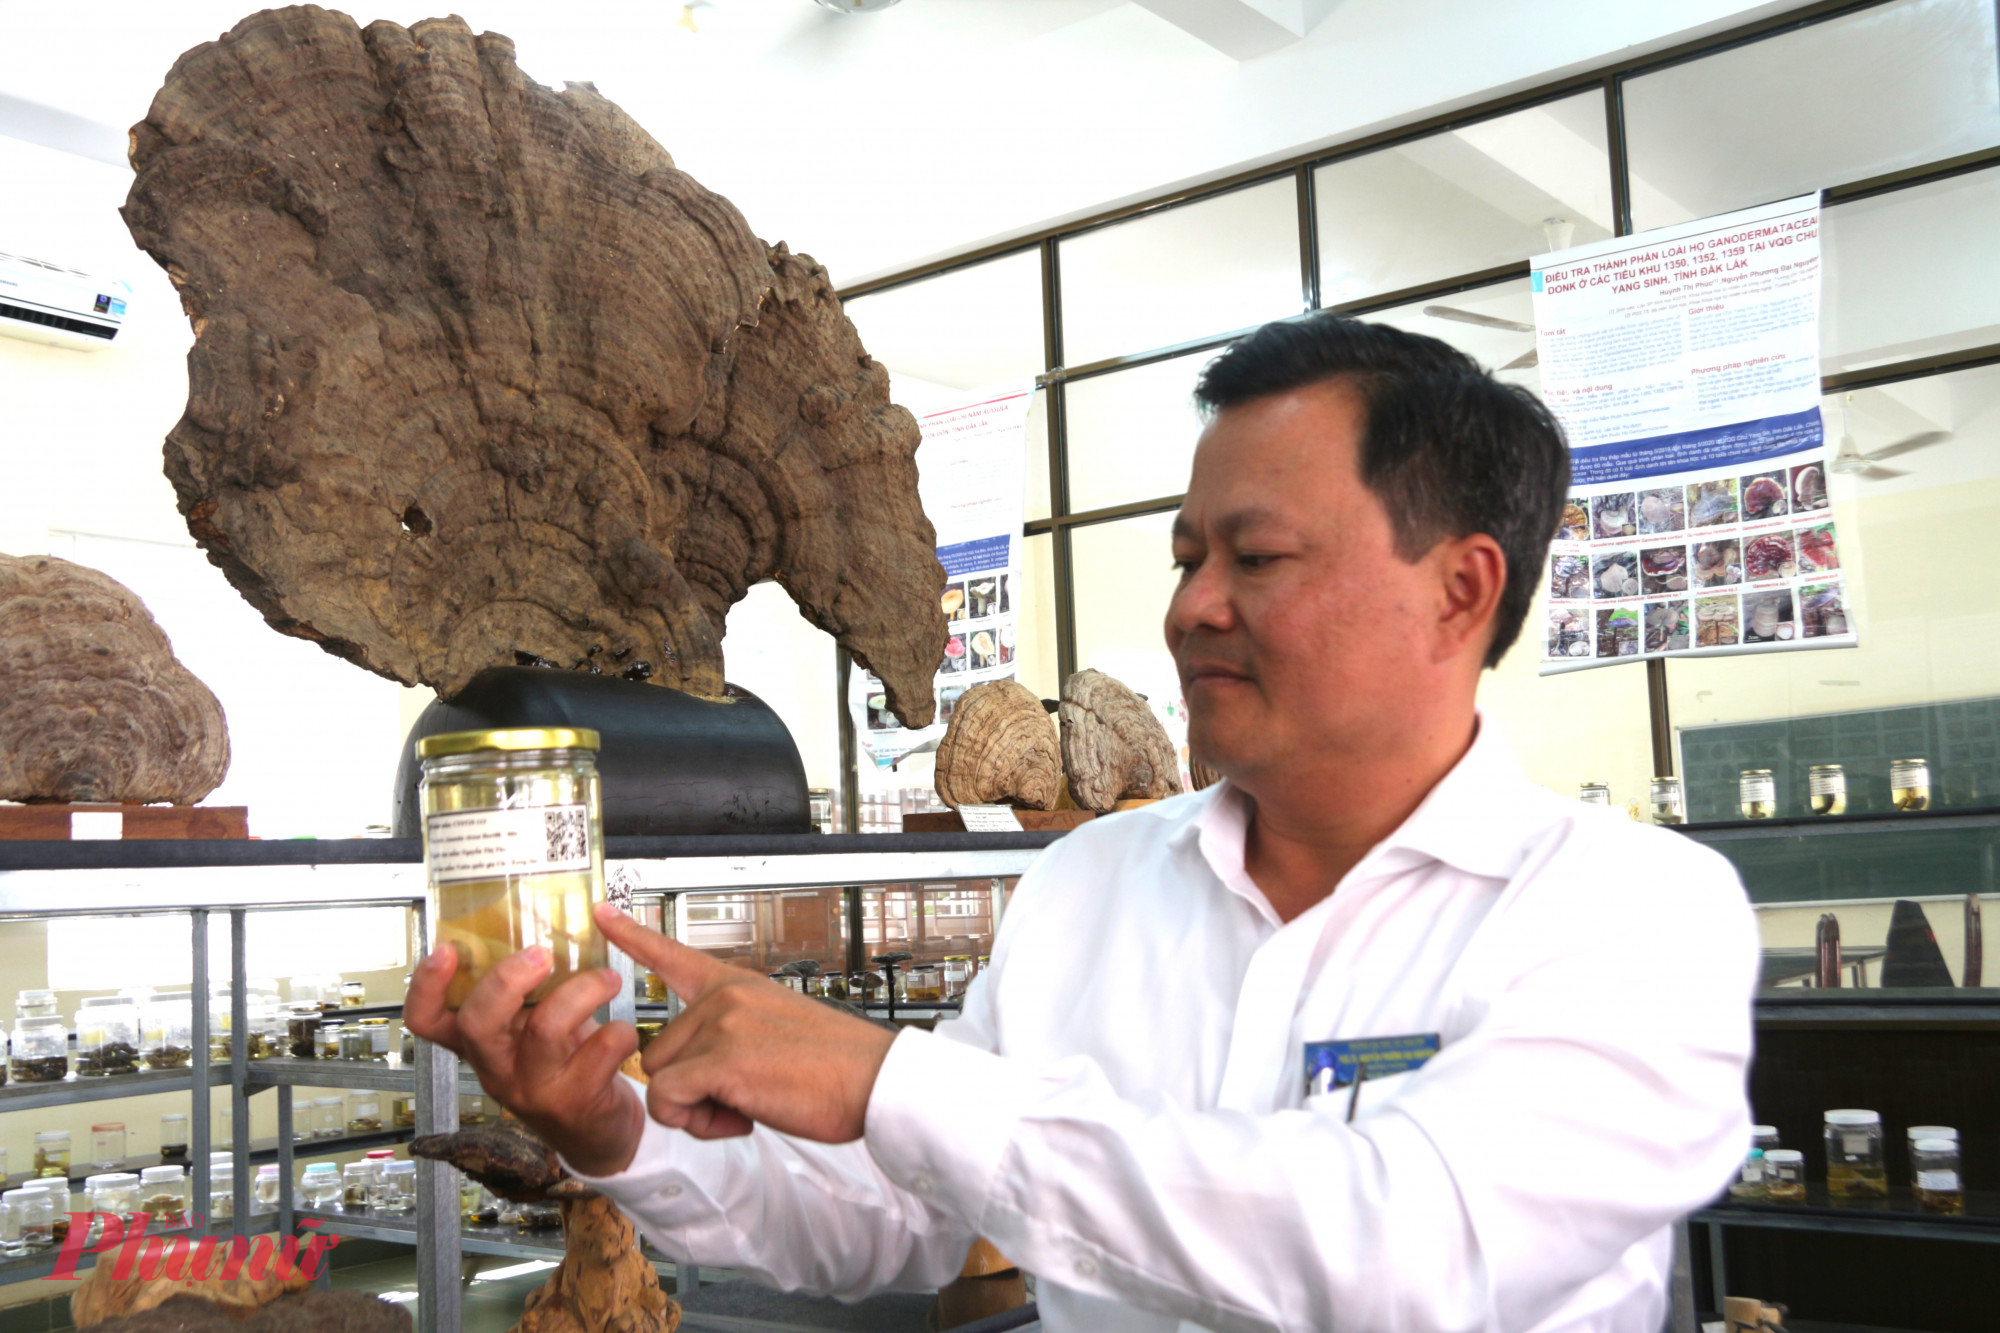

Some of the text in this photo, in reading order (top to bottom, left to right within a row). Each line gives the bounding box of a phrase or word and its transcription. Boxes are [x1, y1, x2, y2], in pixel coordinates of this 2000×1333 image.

[1548, 282, 1577, 295] DONK
[1579, 277, 1587, 289] Ở
[1589, 273, 1611, 287] CÁC
[1639, 264, 1661, 276] KHU
[1722, 246, 1745, 259] 1359
[1749, 241, 1766, 253] TẠI
[1768, 235, 1793, 249] VQG
[1571, 266, 1590, 279] TRA
[1593, 258, 1627, 273] THÀNH
[1662, 244, 1686, 259] LOÀI
[1689, 241, 1705, 253] HỌ
[1611, 281, 1641, 295] YANG
